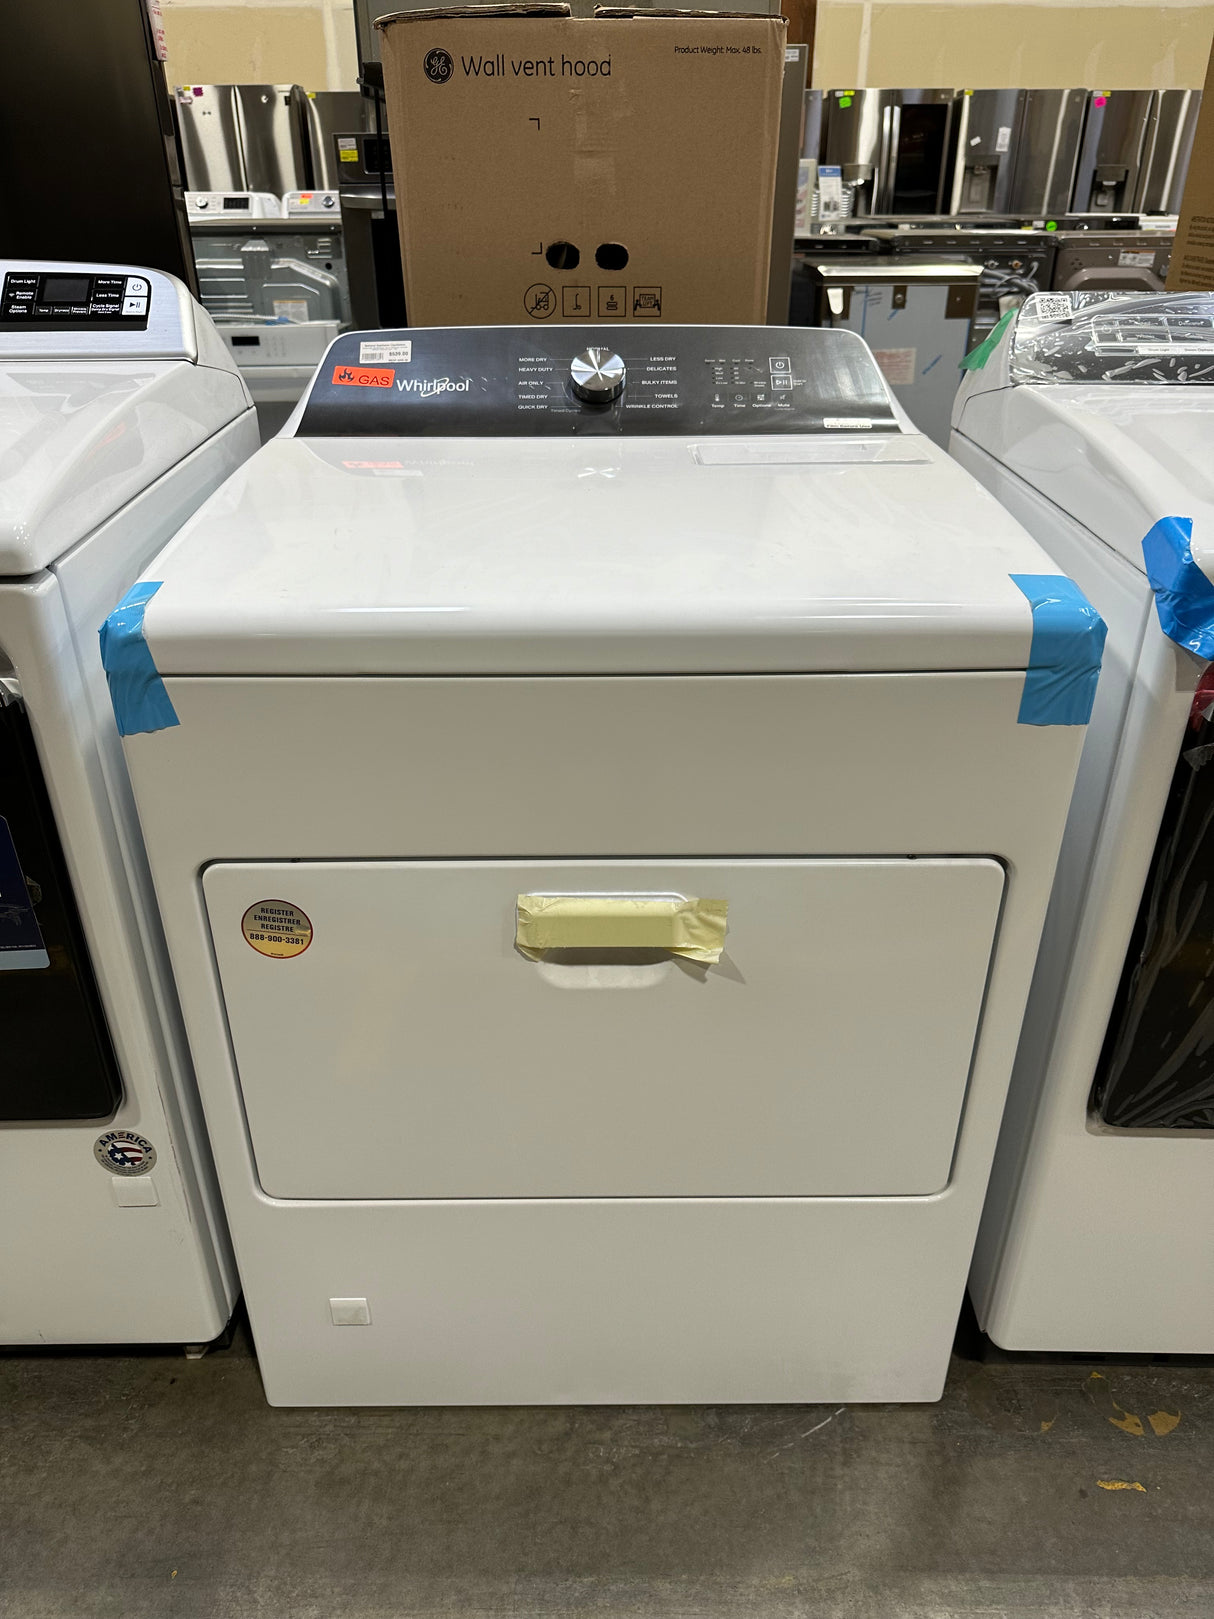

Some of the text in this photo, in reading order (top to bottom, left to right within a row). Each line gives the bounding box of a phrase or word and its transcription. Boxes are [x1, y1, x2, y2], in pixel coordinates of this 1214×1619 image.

[674, 45, 762, 56] Product Weight: Max. 48 lbs.
[461, 54, 611, 77] Wall vent hood
[358, 375, 390, 386] GAS
[397, 378, 469, 397] Whirlpool
[261, 907, 294, 916] REGISTER
[254, 914, 301, 925] ENREGISTRER
[261, 923, 294, 932] REGISTRE
[99, 1131, 152, 1154] AMERICA
